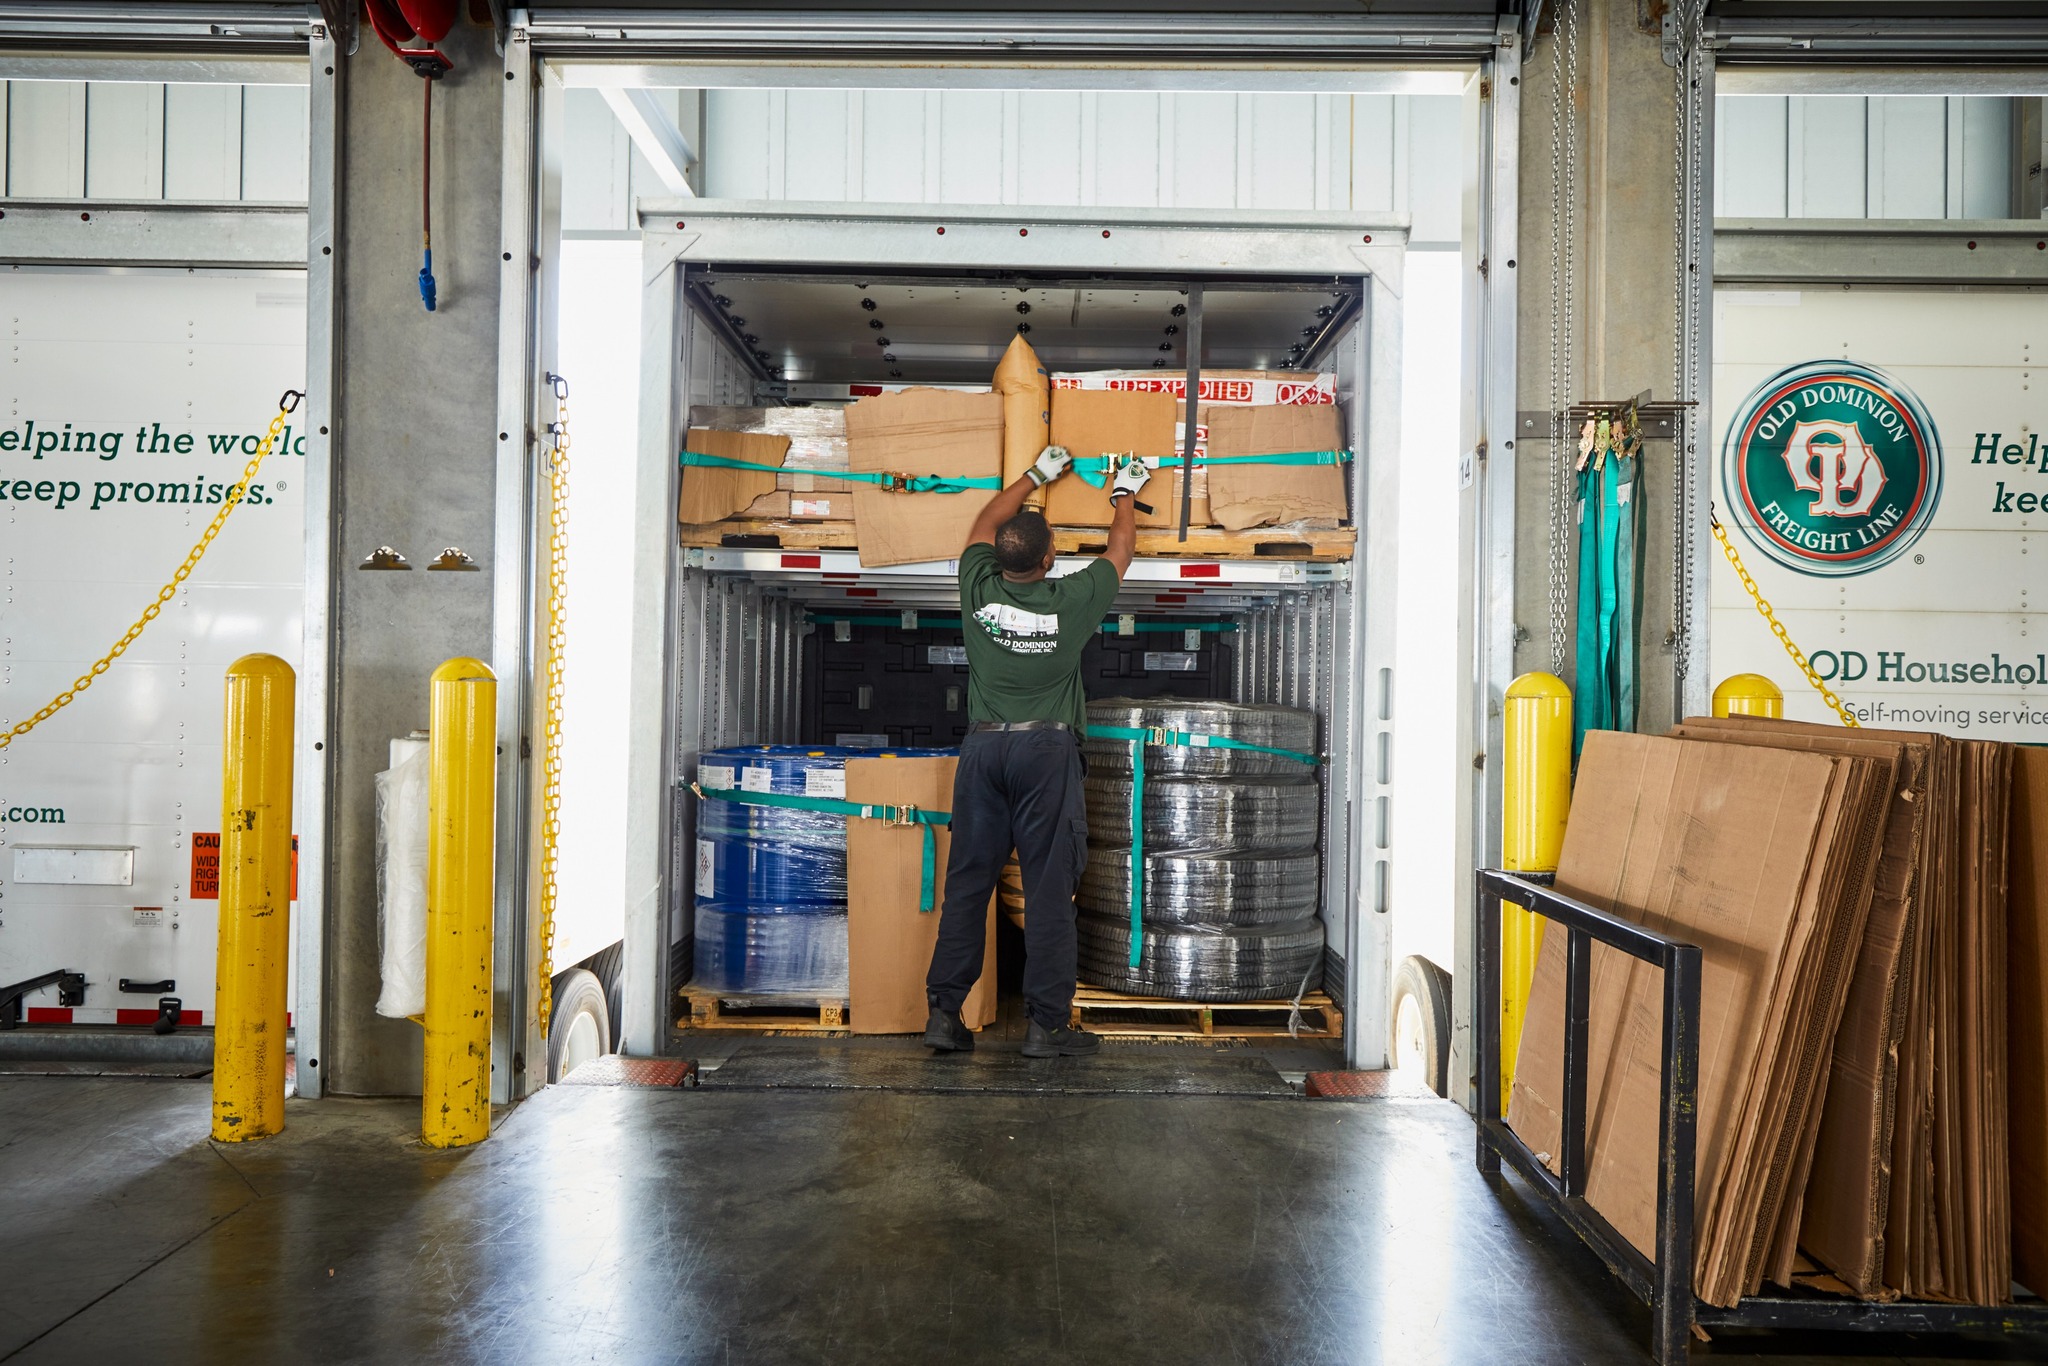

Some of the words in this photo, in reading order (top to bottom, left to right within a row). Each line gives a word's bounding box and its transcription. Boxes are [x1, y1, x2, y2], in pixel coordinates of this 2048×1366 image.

[1758, 399, 1797, 440] OLD
[1801, 385, 1909, 443] DOMINION
[136, 423, 194, 454] the
[1460, 458, 1470, 484] 14
[1761, 500, 1851, 551] FREIGHT
[1856, 503, 1903, 545] LINE
[993, 637, 1011, 647] OLD
[1012, 641, 1057, 649] DOMINION
[1808, 650, 1868, 681] OD
[1843, 701, 1971, 729] Self-moving
[826, 1008, 838, 1018] CP3
